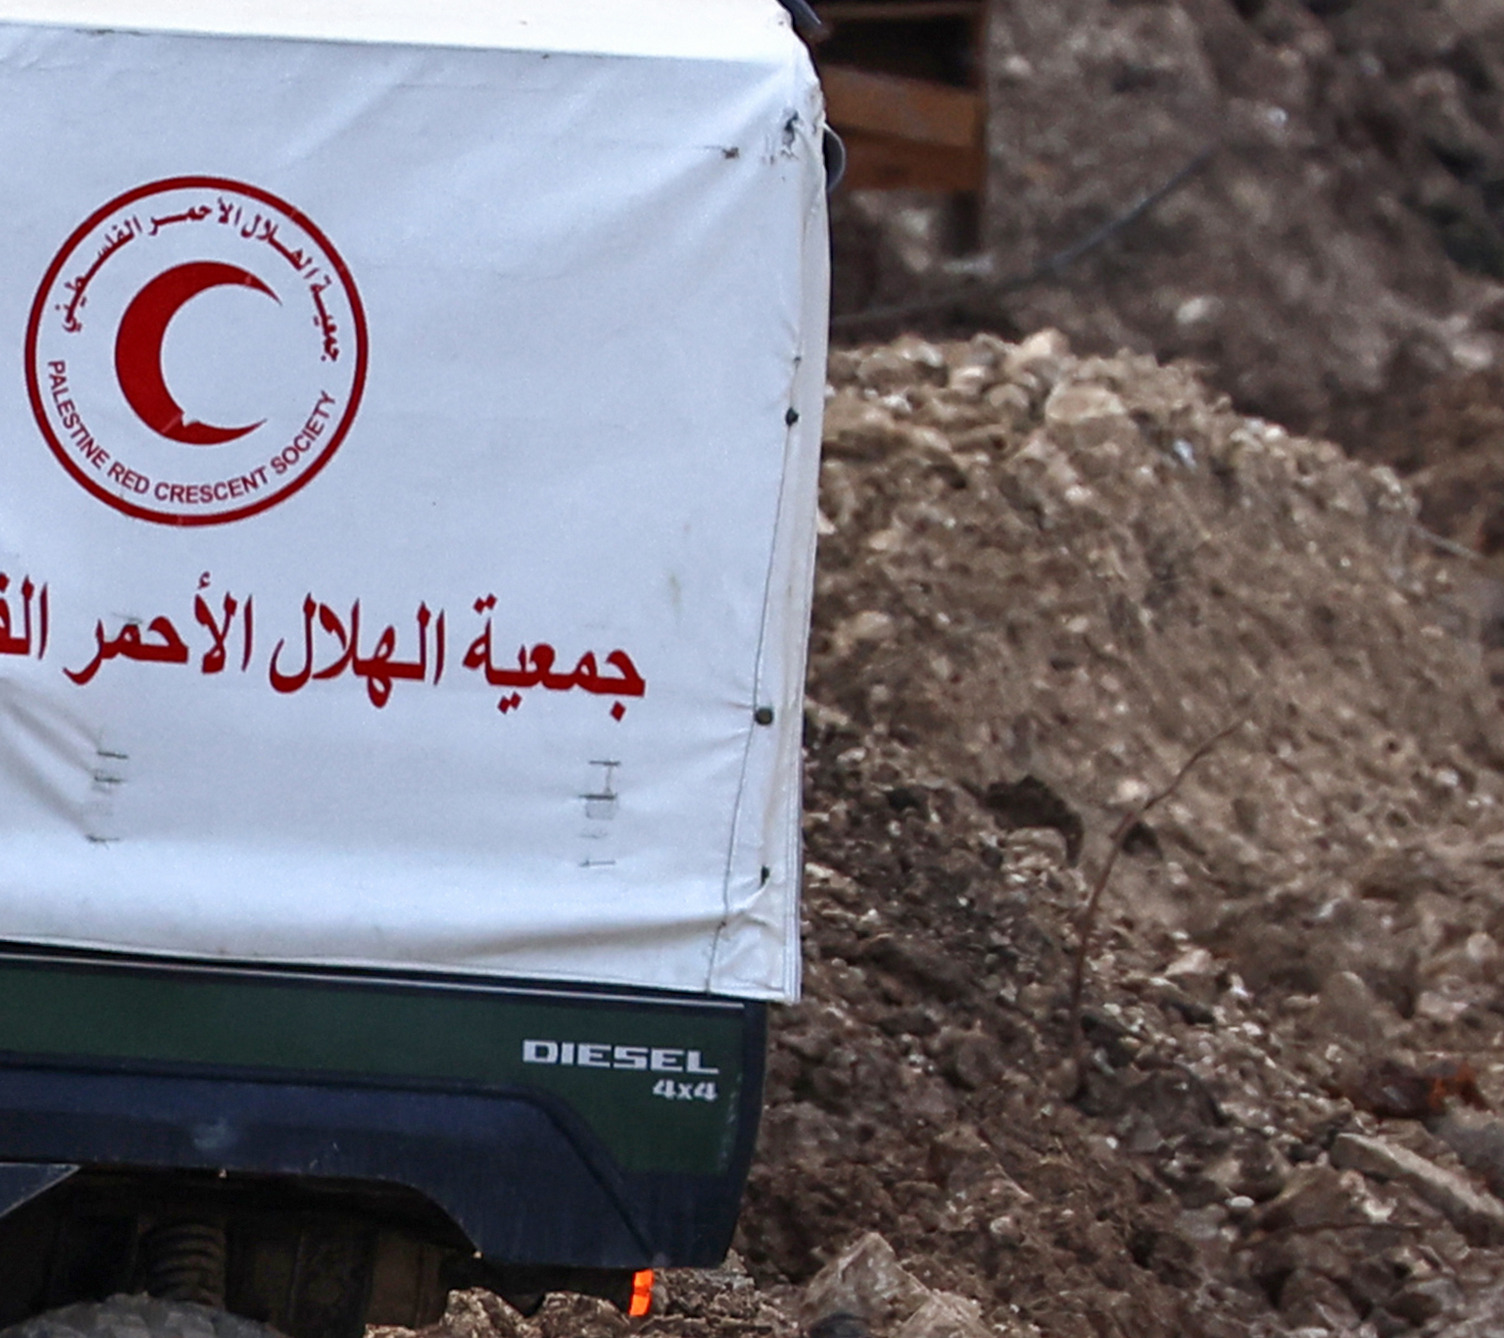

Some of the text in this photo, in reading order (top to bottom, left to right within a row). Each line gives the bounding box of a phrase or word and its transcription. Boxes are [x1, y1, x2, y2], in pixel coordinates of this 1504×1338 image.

[239, 212, 322, 281] الهلال
[308, 273, 340, 363] جمعية
[47, 359, 337, 505] PALESTINE RED CRESCENT SOCIETY
[64, 571, 254, 686] الأحمر
[268, 595, 447, 709] الهلال
[461, 595, 647, 721] جمعية
[522, 1038, 720, 1075] DIESEL
[652, 1078, 718, 1102] 4x4
